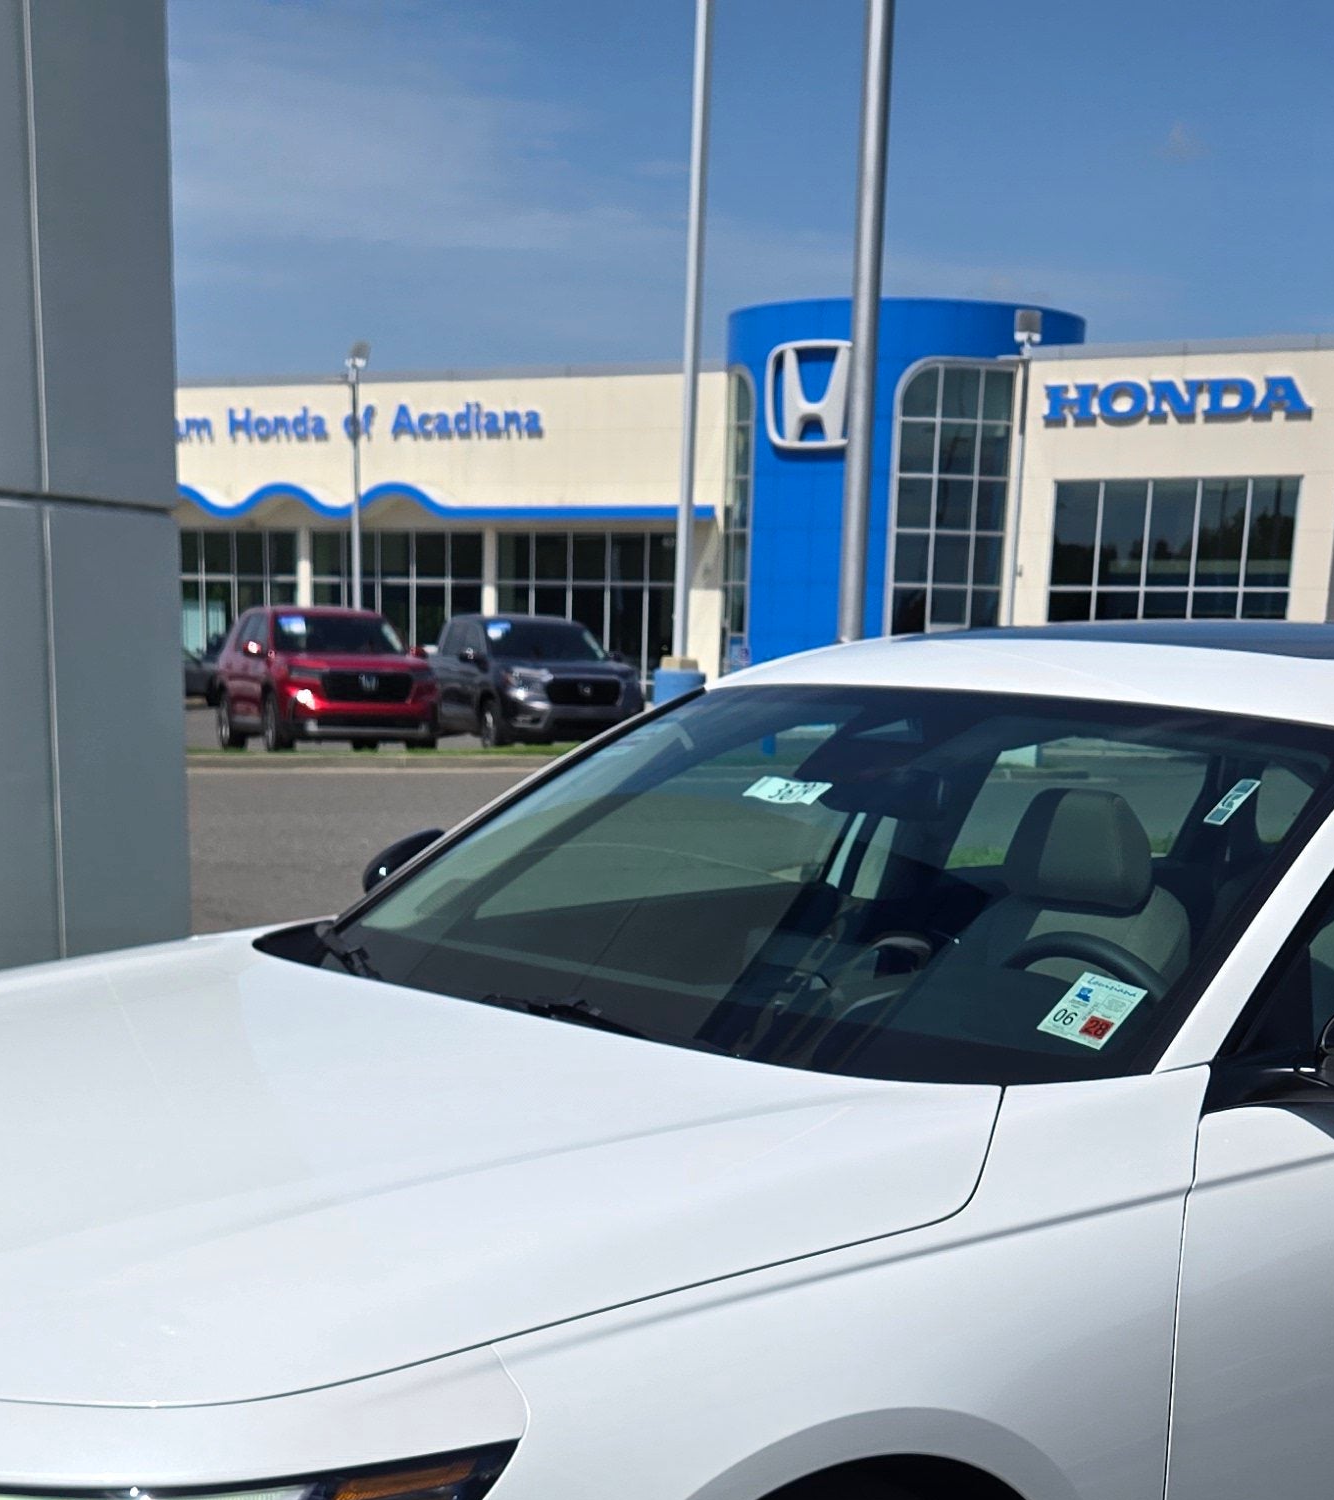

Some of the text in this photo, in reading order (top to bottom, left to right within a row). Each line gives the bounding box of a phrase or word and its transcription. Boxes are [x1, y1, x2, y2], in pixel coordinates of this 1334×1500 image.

[1042, 375, 1313, 426] HONDA
[227, 406, 329, 440] Honda
[343, 404, 376, 440] of
[390, 402, 544, 440] Acadiana
[1087, 976, 1137, 997] Louisiana
[1052, 1008, 1078, 1025] 06
[1085, 1018, 1109, 1038] 28
